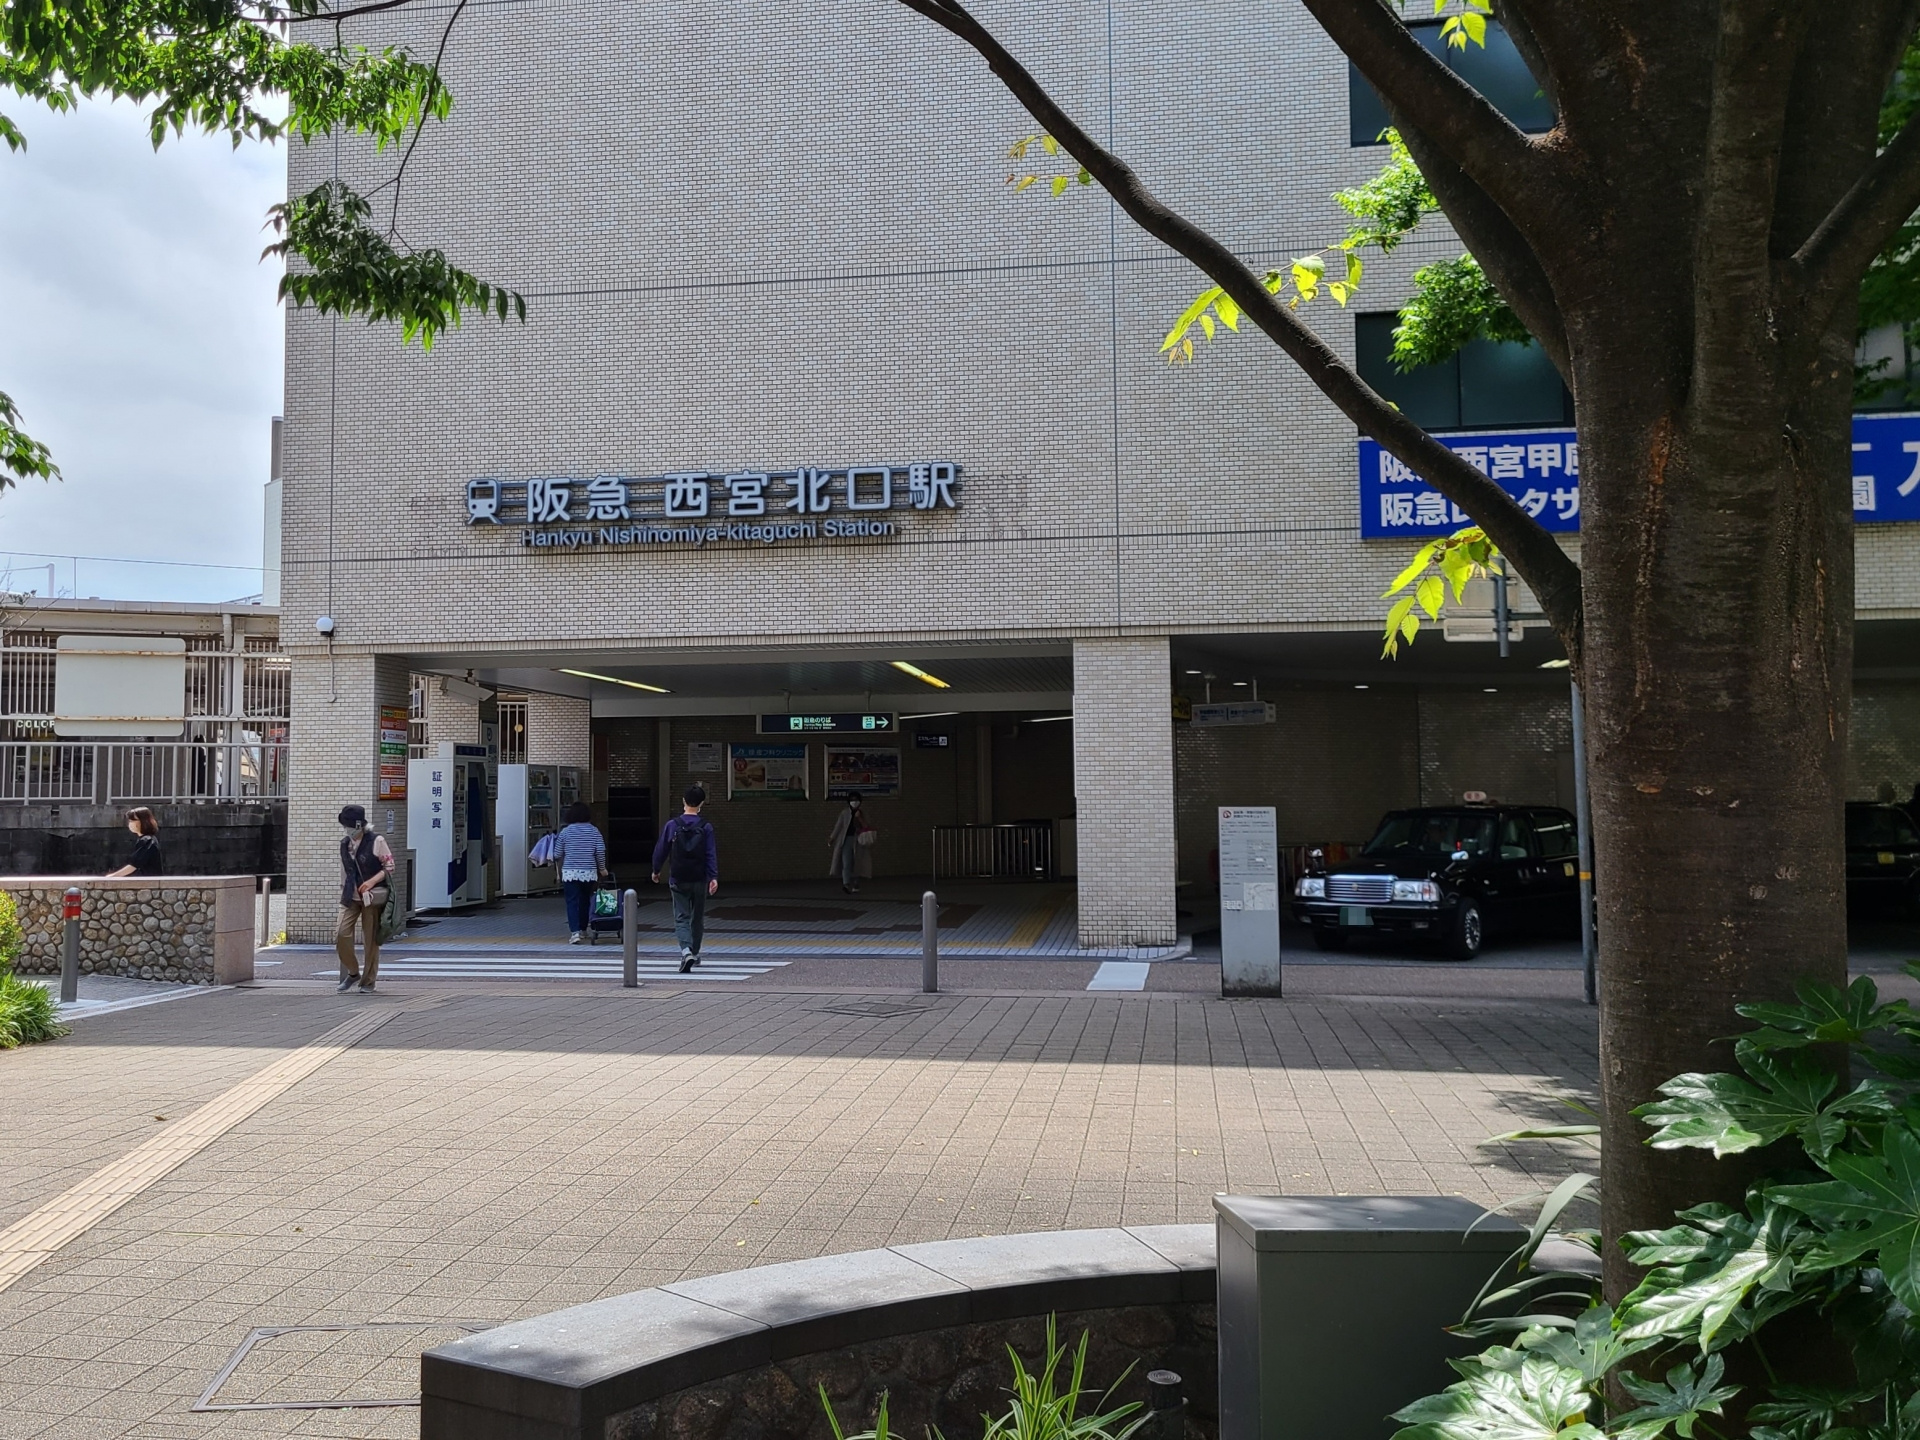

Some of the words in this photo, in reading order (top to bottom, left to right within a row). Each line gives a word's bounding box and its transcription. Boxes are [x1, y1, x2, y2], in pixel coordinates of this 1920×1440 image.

[526, 474, 631, 523] 阪急
[663, 461, 956, 518] 西宮北口駅
[521, 527, 593, 548] Hankyu
[600, 519, 817, 545] Nishinomiya-kitaguchi
[823, 517, 896, 538] Station
[431, 770, 442, 829] 証明写真
